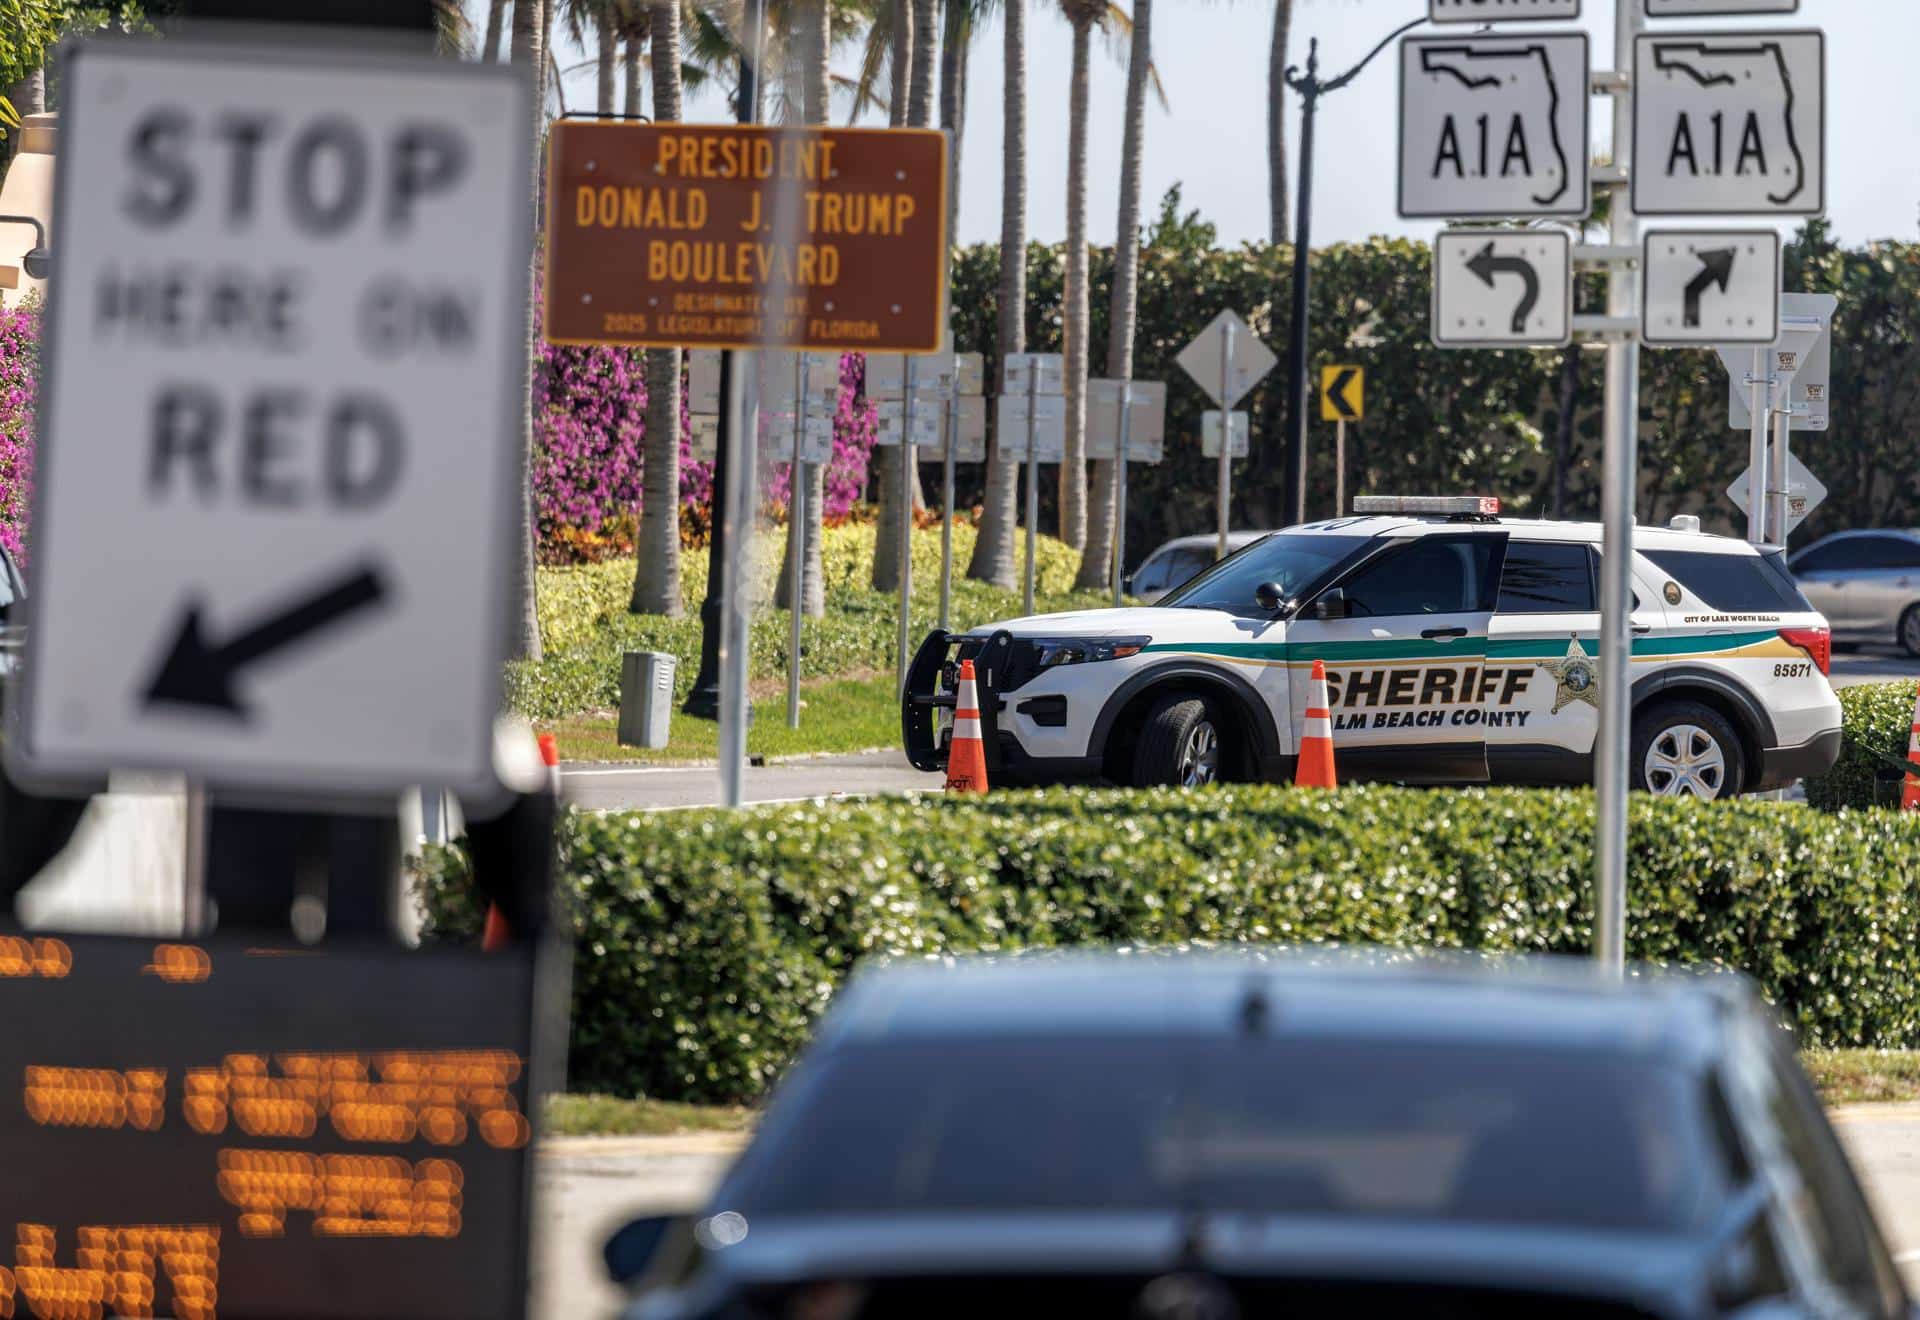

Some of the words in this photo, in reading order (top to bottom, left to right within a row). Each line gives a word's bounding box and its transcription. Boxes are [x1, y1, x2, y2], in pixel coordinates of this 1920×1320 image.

[658, 135, 836, 181] PRESIDENT
[1432, 113, 1533, 178] A1A
[1665, 111, 1767, 176] A1A
[121, 106, 472, 241] STOP
[576, 185, 708, 231] DONALD
[740, 191, 772, 232] J.
[804, 191, 916, 236] TRUMP
[648, 240, 840, 286] BOULEVARD
[94, 259, 304, 353] HERE
[357, 275, 482, 362] ON
[809, 320, 881, 339] FLORIDA
[146, 382, 409, 511] RED
[1325, 667, 1535, 707] SHERIFF
[1774, 663, 1811, 677] 85871
[1330, 712, 1367, 730] LM
[1372, 710, 1446, 729] BEACH
